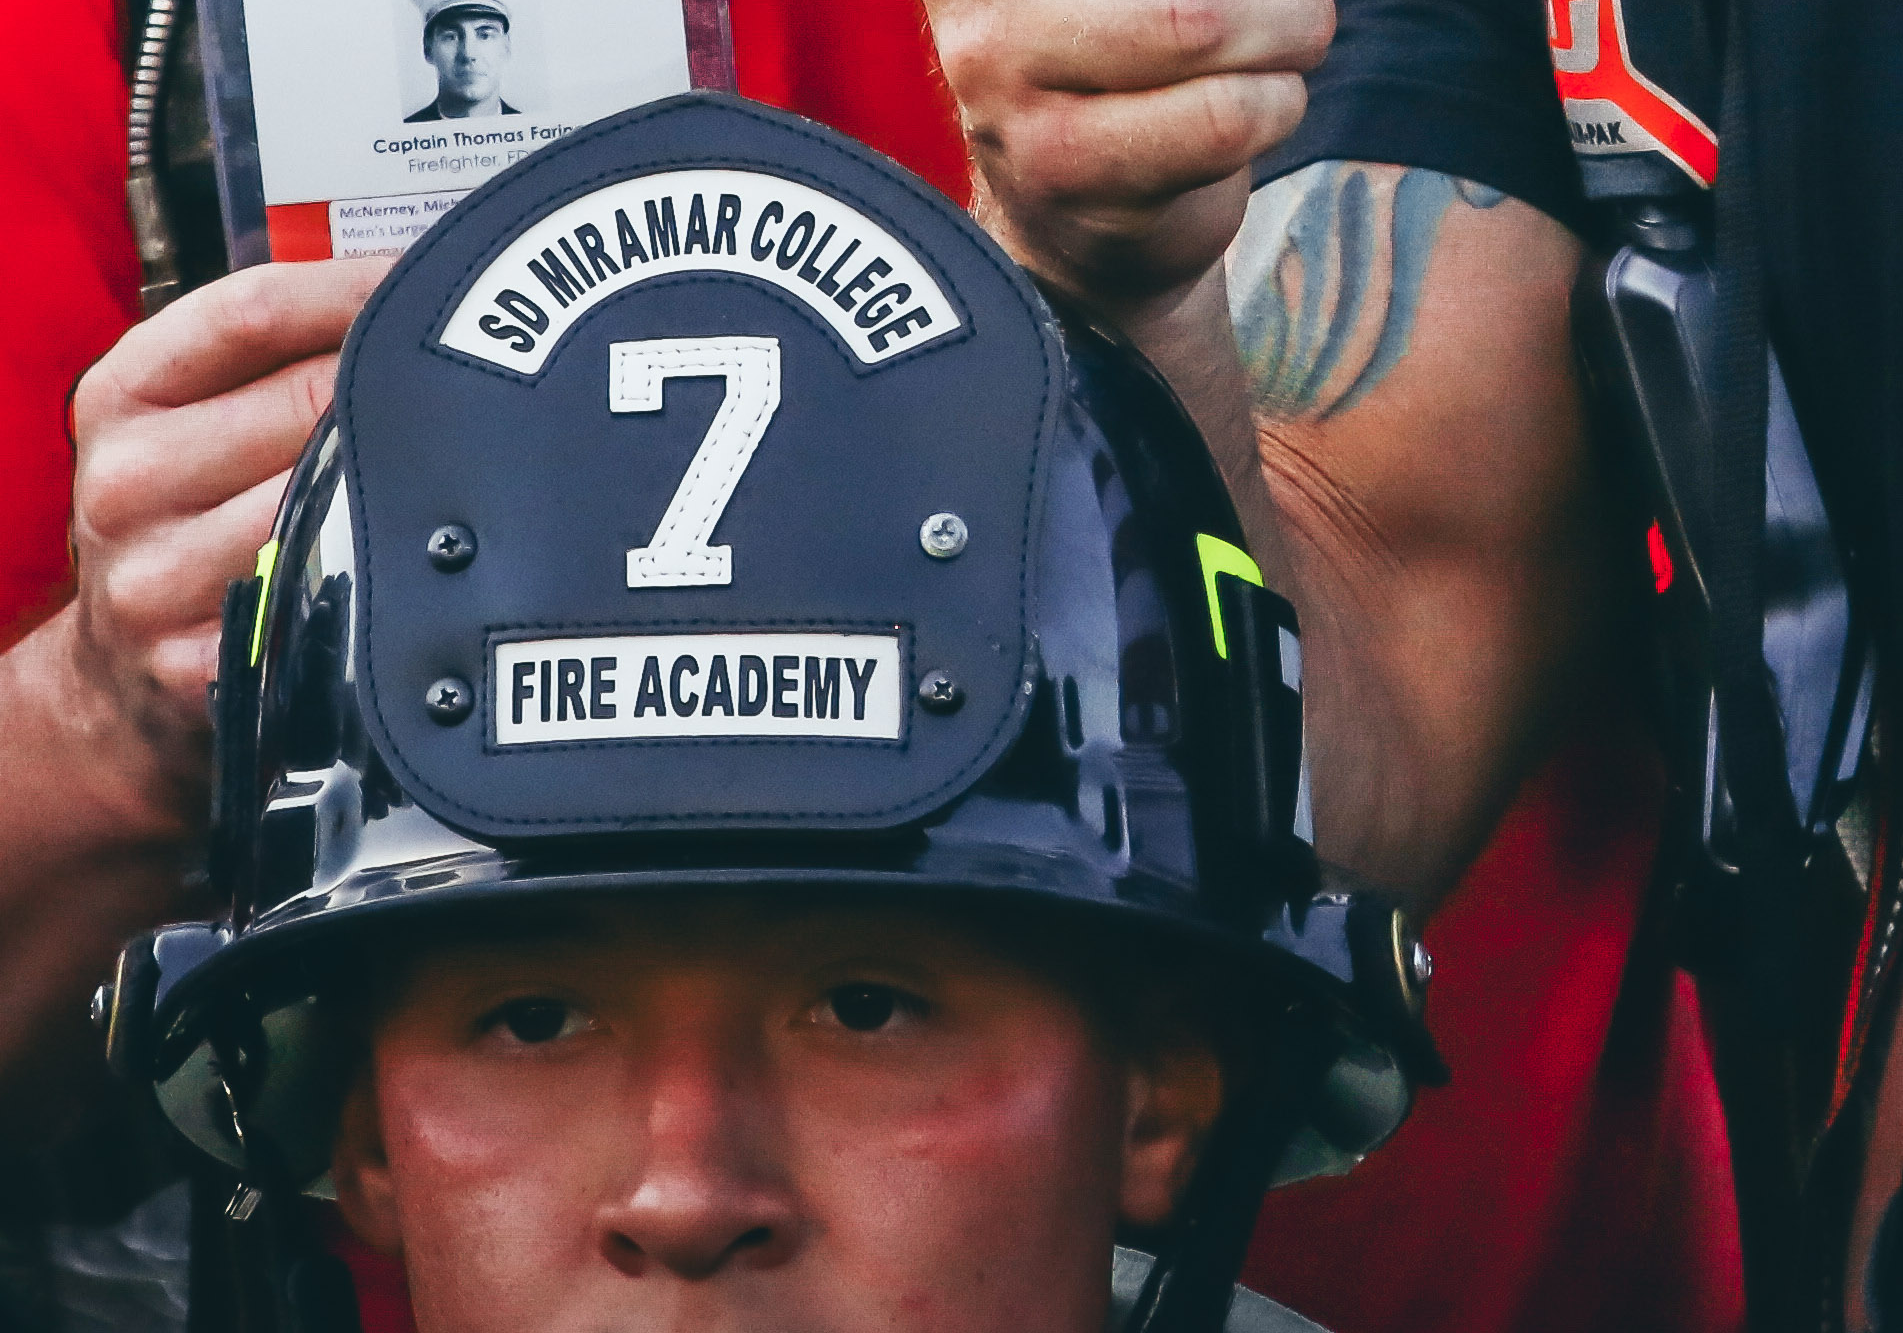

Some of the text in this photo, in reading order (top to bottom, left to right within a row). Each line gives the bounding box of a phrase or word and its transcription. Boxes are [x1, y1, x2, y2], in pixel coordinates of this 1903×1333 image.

[373, 137, 447, 155] Captain
[453, 131, 525, 147] Thomas
[409, 150, 530, 174] Firefighter, FD
[340, 205, 419, 219] McNerney,
[478, 193, 933, 354] SD MIRAMAR COLLEGE
[608, 335, 783, 589] 7
[511, 653, 879, 725] FIRE ACADEMY
